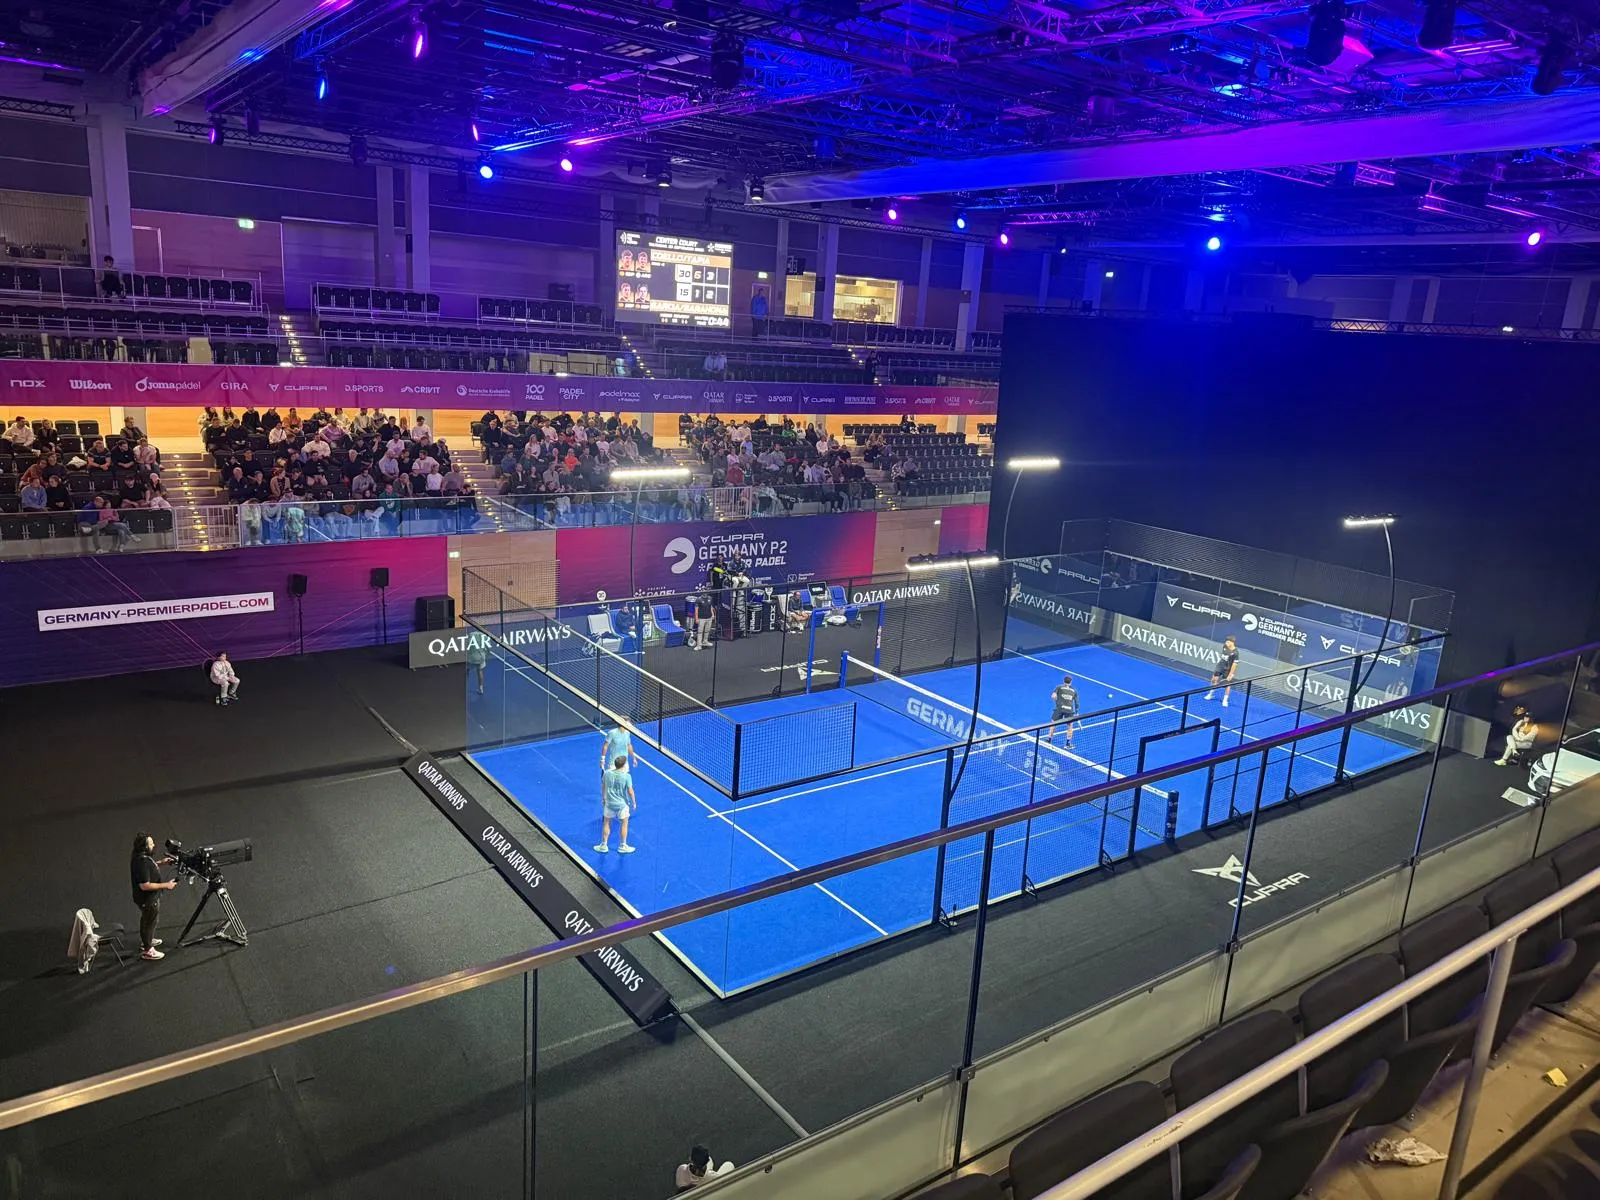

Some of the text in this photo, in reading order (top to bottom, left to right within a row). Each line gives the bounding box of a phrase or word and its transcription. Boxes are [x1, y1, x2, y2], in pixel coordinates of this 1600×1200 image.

[679, 270, 691, 278] 30
[679, 288, 690, 297] 15
[705, 290, 714, 299] 2
[69, 379, 113, 390] Wilson
[220, 382, 249, 391] GIRA
[525, 384, 545, 394] 100
[559, 387, 585, 395] PADEL
[703, 391, 725, 399] QATAR
[711, 533, 764, 543] CUPRA
[699, 541, 788, 560] GERMANY P2
[755, 556, 786, 567] PADEL
[853, 589, 892, 604] QATAR
[892, 584, 940, 599] AIRWAYS
[44, 597, 269, 625] GERMANY-PREMIERPADEL.COM
[1182, 602, 1231, 620] CUPRA
[1258, 621, 1308, 642] GERMANY P2
[428, 635, 492, 657] QATAR
[1121, 623, 1222, 664] QATAR AIRWAY
[1286, 674, 1344, 703] QATAR
[418, 761, 468, 810] QATAR AIRWAYS
[482, 826, 543, 888] QATAR AIRWAYS
[1228, 872, 1310, 908] CUPRA
[564, 910, 644, 992] QATA AIRWAYS
